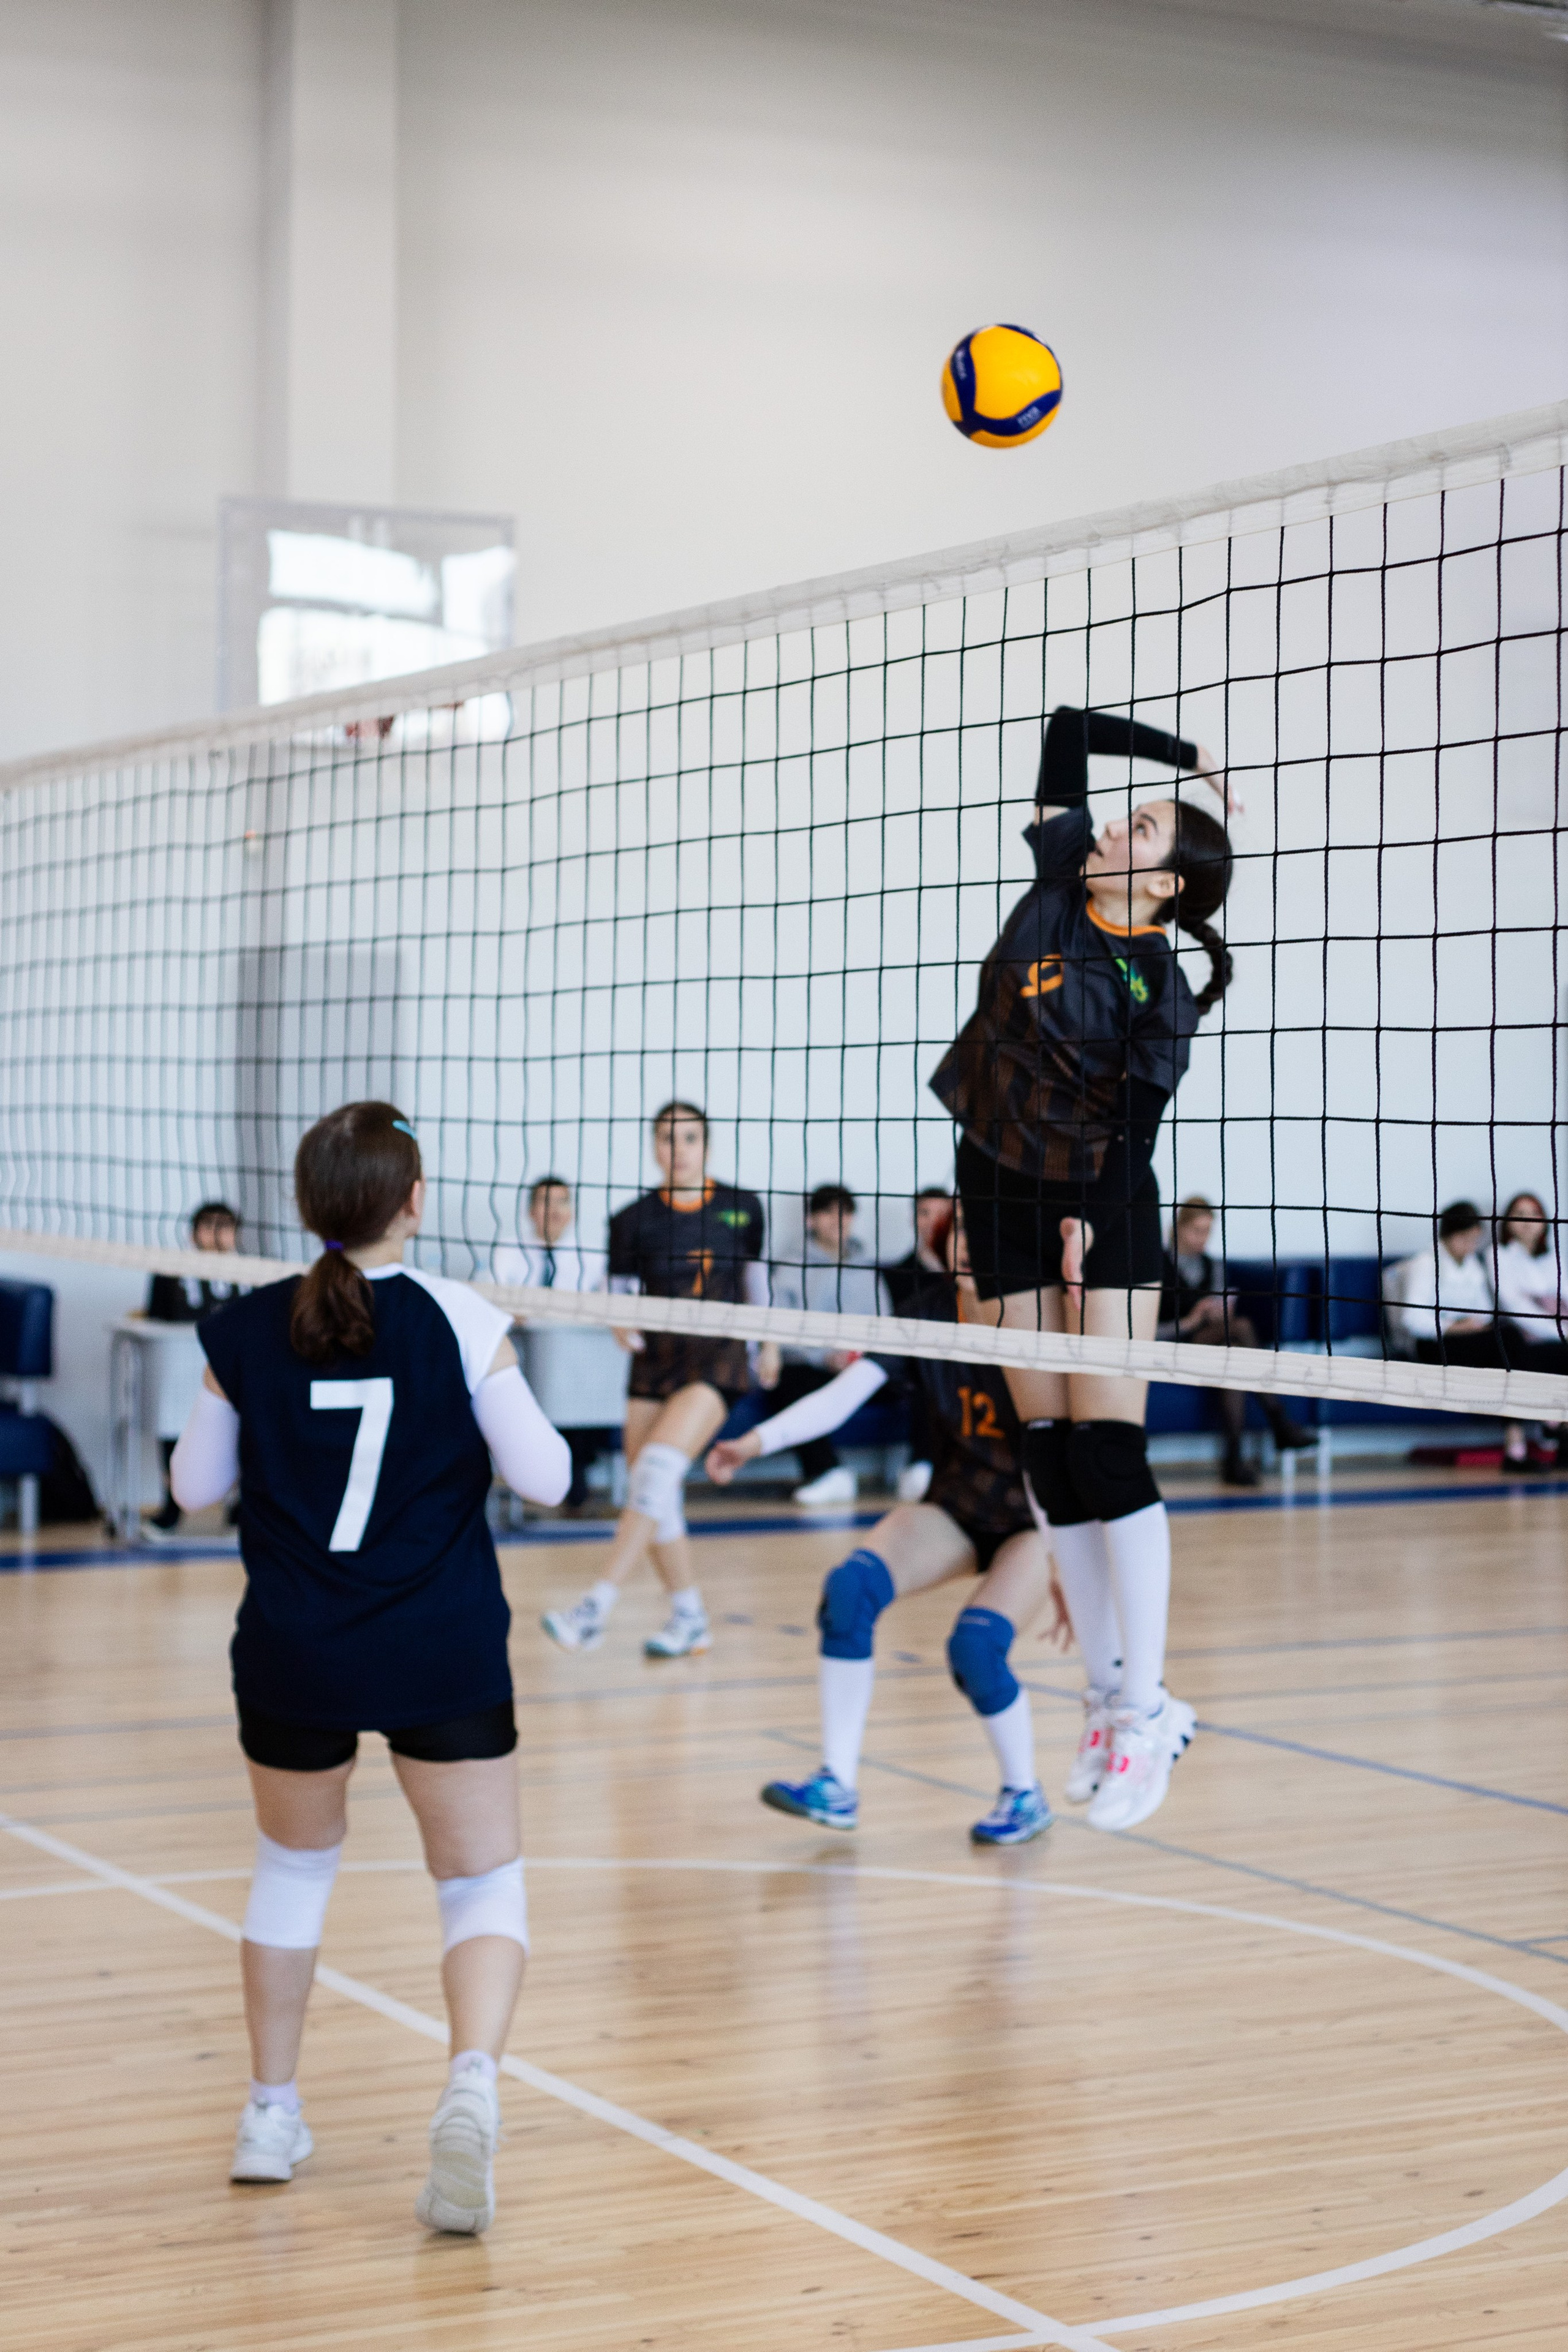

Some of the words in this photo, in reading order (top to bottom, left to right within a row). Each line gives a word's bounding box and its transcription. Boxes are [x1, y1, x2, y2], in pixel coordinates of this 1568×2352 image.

[686, 1248, 714, 1296] 7
[957, 1387, 1005, 1438] 12
[311, 1377, 394, 1551] 7
